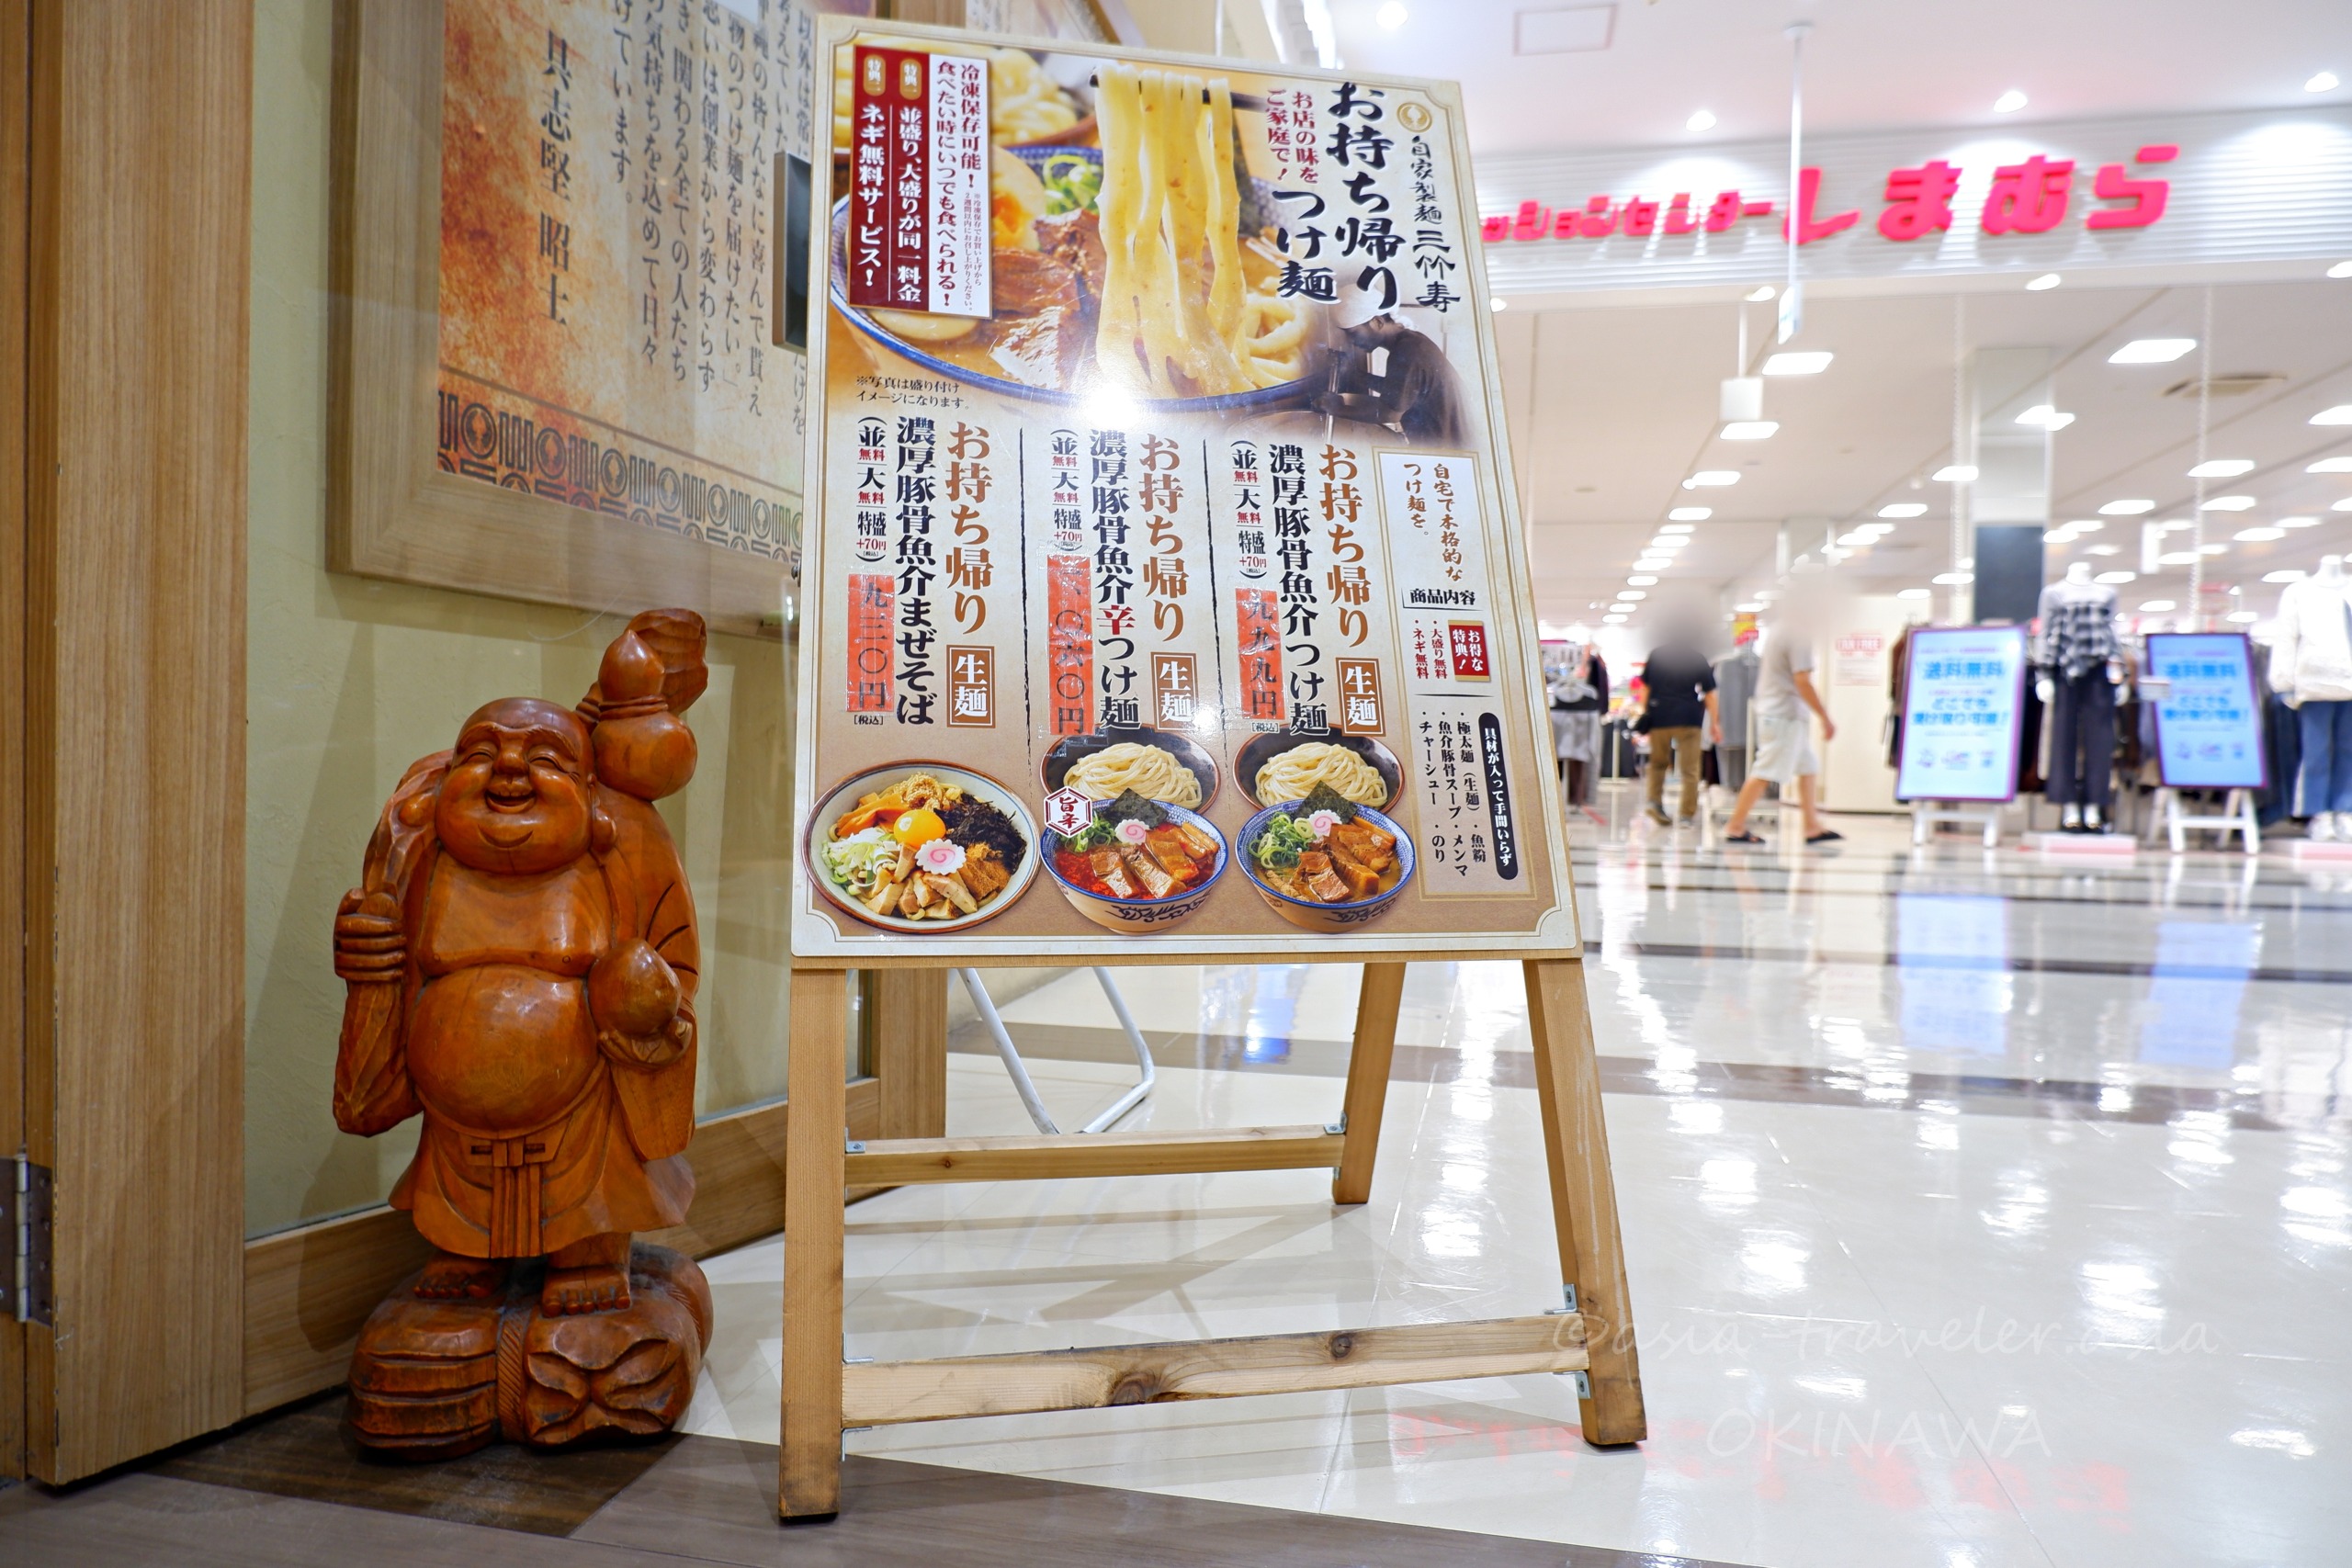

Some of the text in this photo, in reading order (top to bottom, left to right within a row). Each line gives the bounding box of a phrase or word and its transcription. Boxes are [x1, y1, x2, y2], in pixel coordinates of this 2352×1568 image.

[960, 64, 981, 188] 冷凍保存可能！
[1265, 88, 1291, 181] ご家庭で！
[1293, 91, 1319, 184] お店の味を
[539, 29, 572, 326] 具志堅 昭士
[858, 104, 886, 287] ネギ無料サービス！
[898, 106, 922, 303] 並盛り、大盛りが同一料金
[936, 62, 957, 307] 食べたい時にいつでも食べられる！
[1326, 81, 1407, 310] お持ち帰り
[1781, 143, 2180, 244] しまむら
[1272, 188, 1340, 304] つけ麺
[855, 375, 961, 394] ※写真は盛り付け
[856, 390, 970, 411] イメージになります。
[858, 448, 886, 461] 無料
[1052, 456, 1078, 468] 無料
[1234, 470, 1258, 483] 無料
[857, 511, 887, 536] 特盛
[858, 491, 885, 504] 無料
[945, 421, 995, 635] お持ち帰り
[1053, 491, 1079, 503] 無料
[1054, 508, 1082, 530] 特盛
[1237, 512, 1261, 525] 無料
[1403, 463, 1429, 536] つけ麺を。
[1433, 463, 1463, 581] 自宅で本格的な
[895, 415, 938, 725] 濃厚豚骨魚介まぜそば
[1139, 433, 1189, 642] お持ち帰り
[1238, 530, 1266, 555] 特盛
[1318, 444, 1373, 648] お持ち帰り
[1090, 429, 1142, 729] 濃厚豚骨魚介辛つけ麺
[1269, 444, 1329, 736] 濃厚豚骨魚介つけ麺
[1409, 588, 1476, 606] 商品内容
[954, 653, 988, 717] 生麺
[1452, 629, 1469, 671] 特典！
[1467, 630, 1484, 671] お得な
[1159, 660, 1192, 722] 生麺
[1344, 666, 1378, 726] 生麺
[1057, 796, 1080, 829] 旨辛
[1484, 727, 1512, 867] 具材が入って手間いらず
